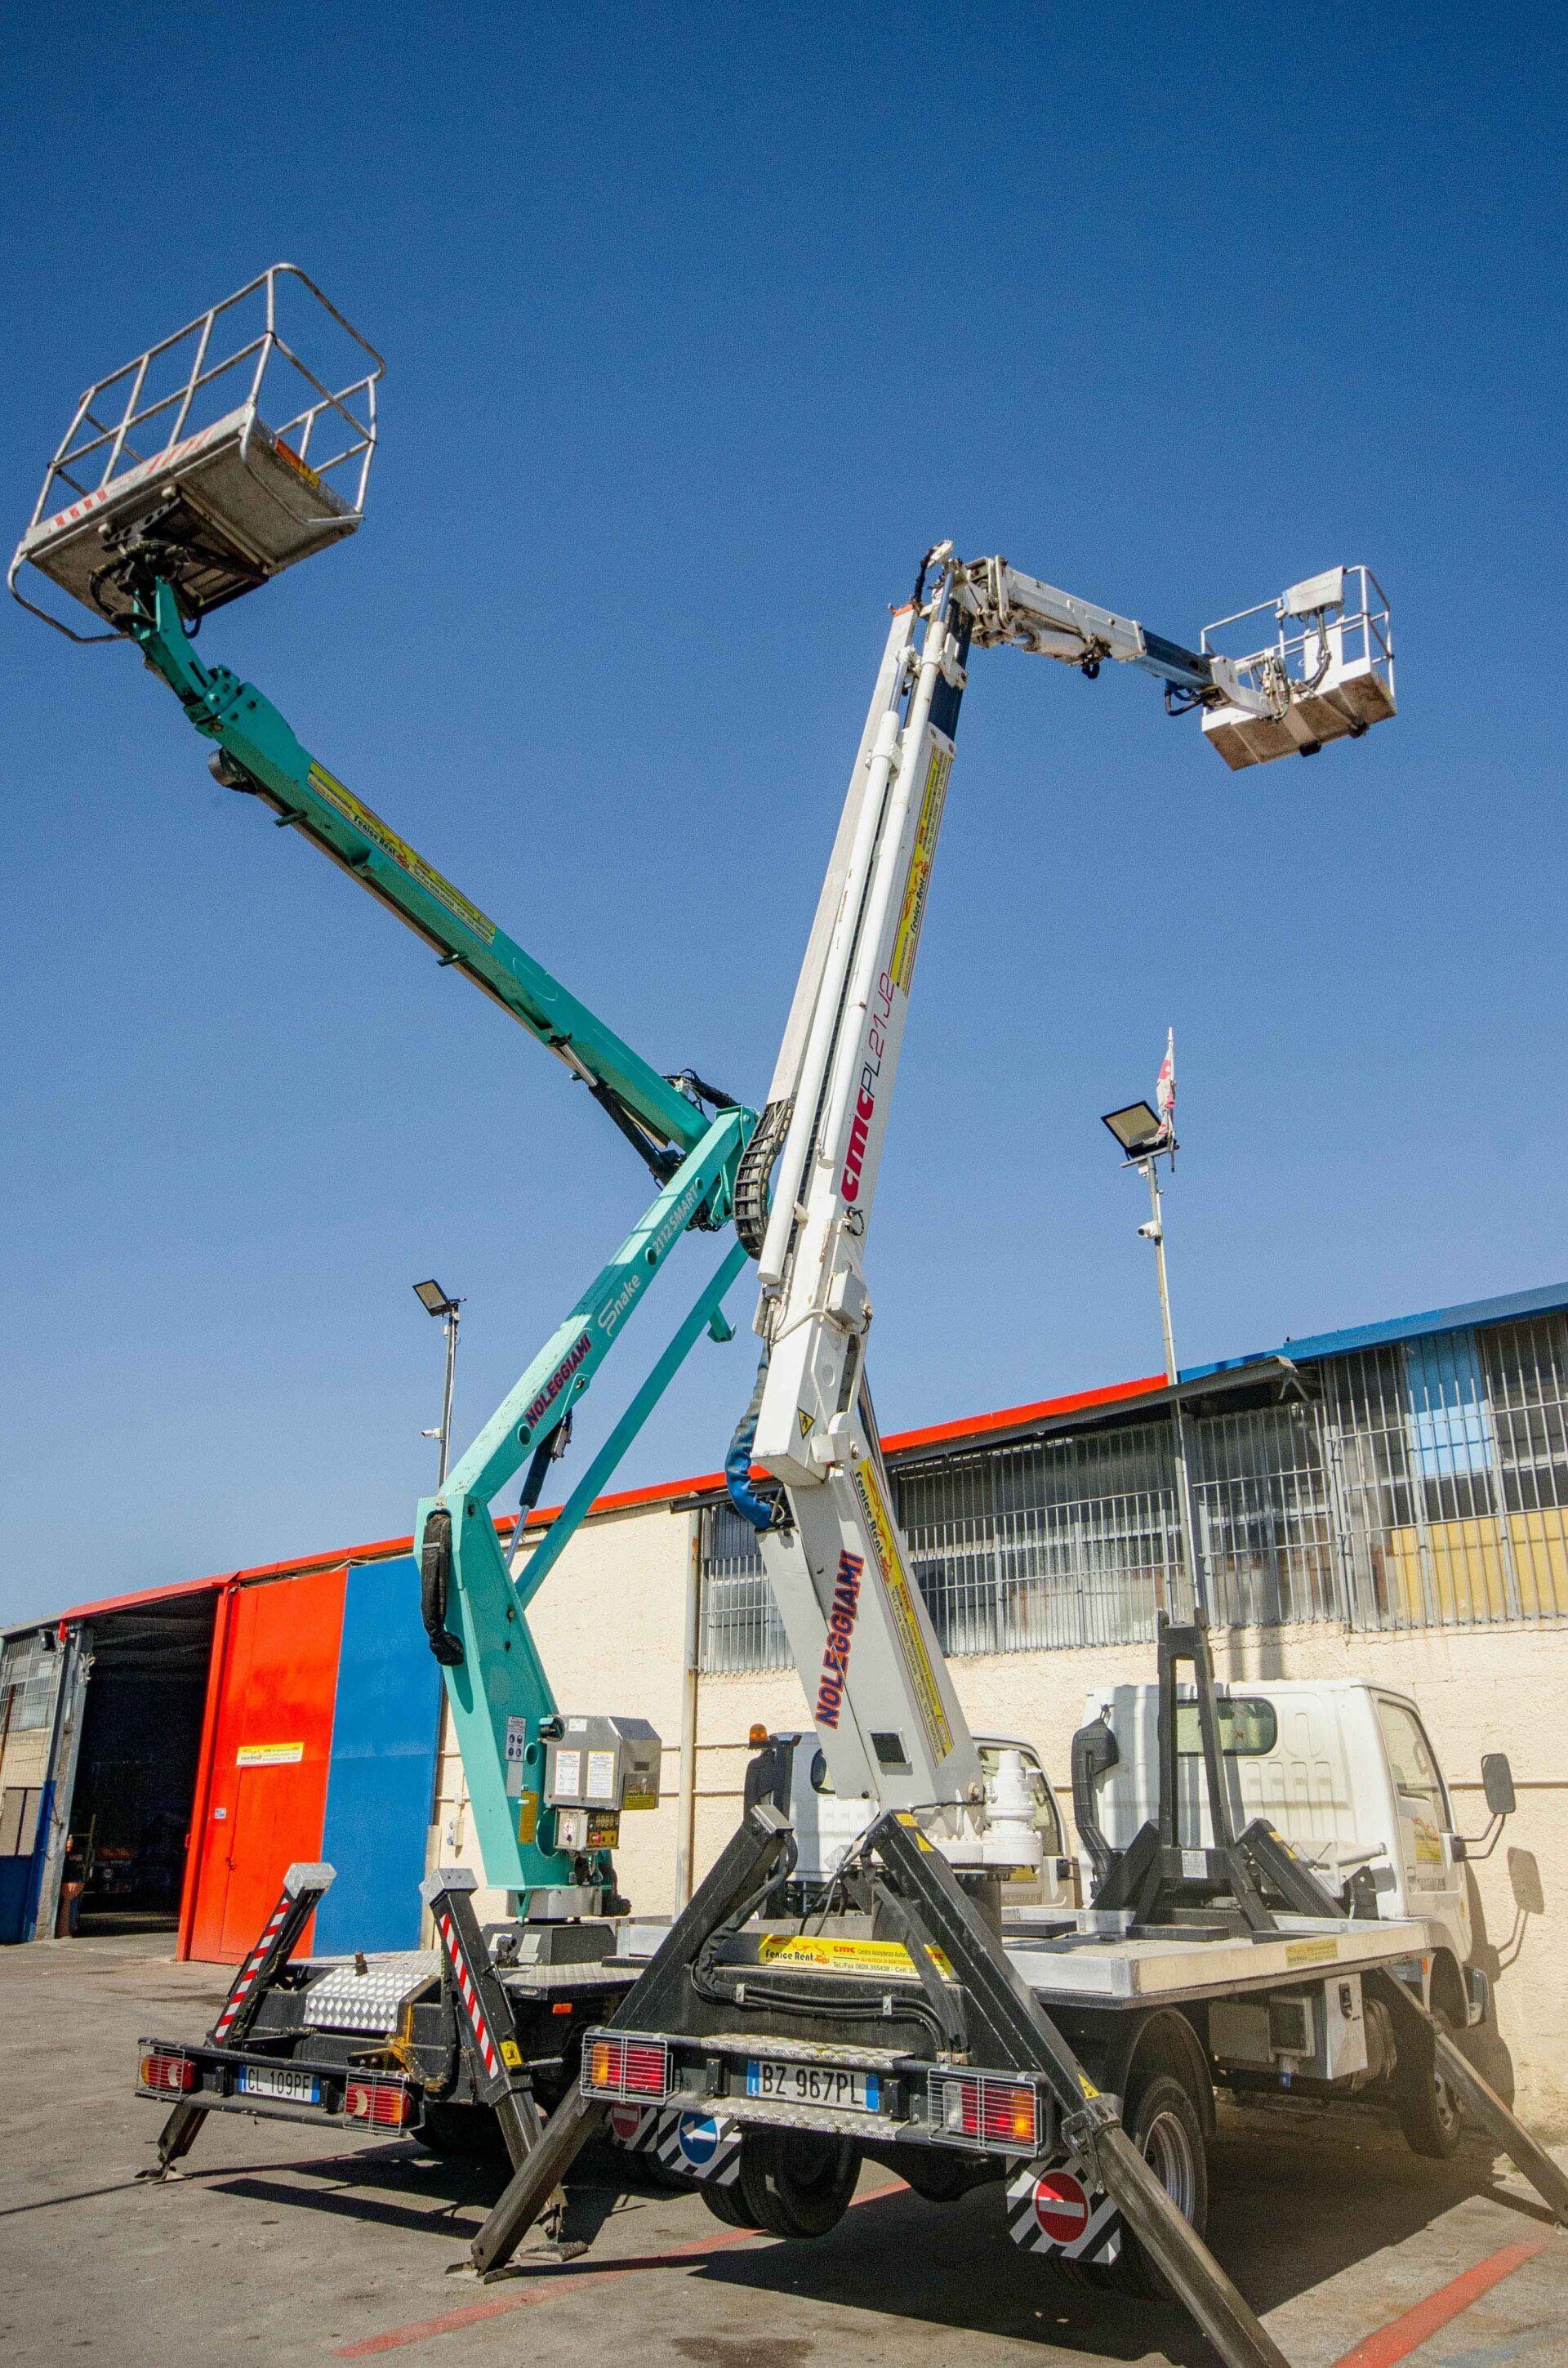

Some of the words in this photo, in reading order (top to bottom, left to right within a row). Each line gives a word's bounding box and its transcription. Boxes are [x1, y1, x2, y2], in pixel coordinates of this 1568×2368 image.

[670, 1185, 699, 1229] SMART
[598, 1274, 641, 1337] Snake
[524, 1332, 592, 1430] NOLEGGIAMI
[869, 1520, 883, 1554] Rent
[815, 1549, 865, 1729] NOLEGGIAMI
[765, 1949, 793, 1960] Fenice
[795, 1951, 813, 1961] Rent
[247, 2068, 263, 2091] CL
[270, 2071, 310, 2098] 109PF
[762, 2063, 786, 2095] BZ
[795, 2068, 863, 2104] 967PL
